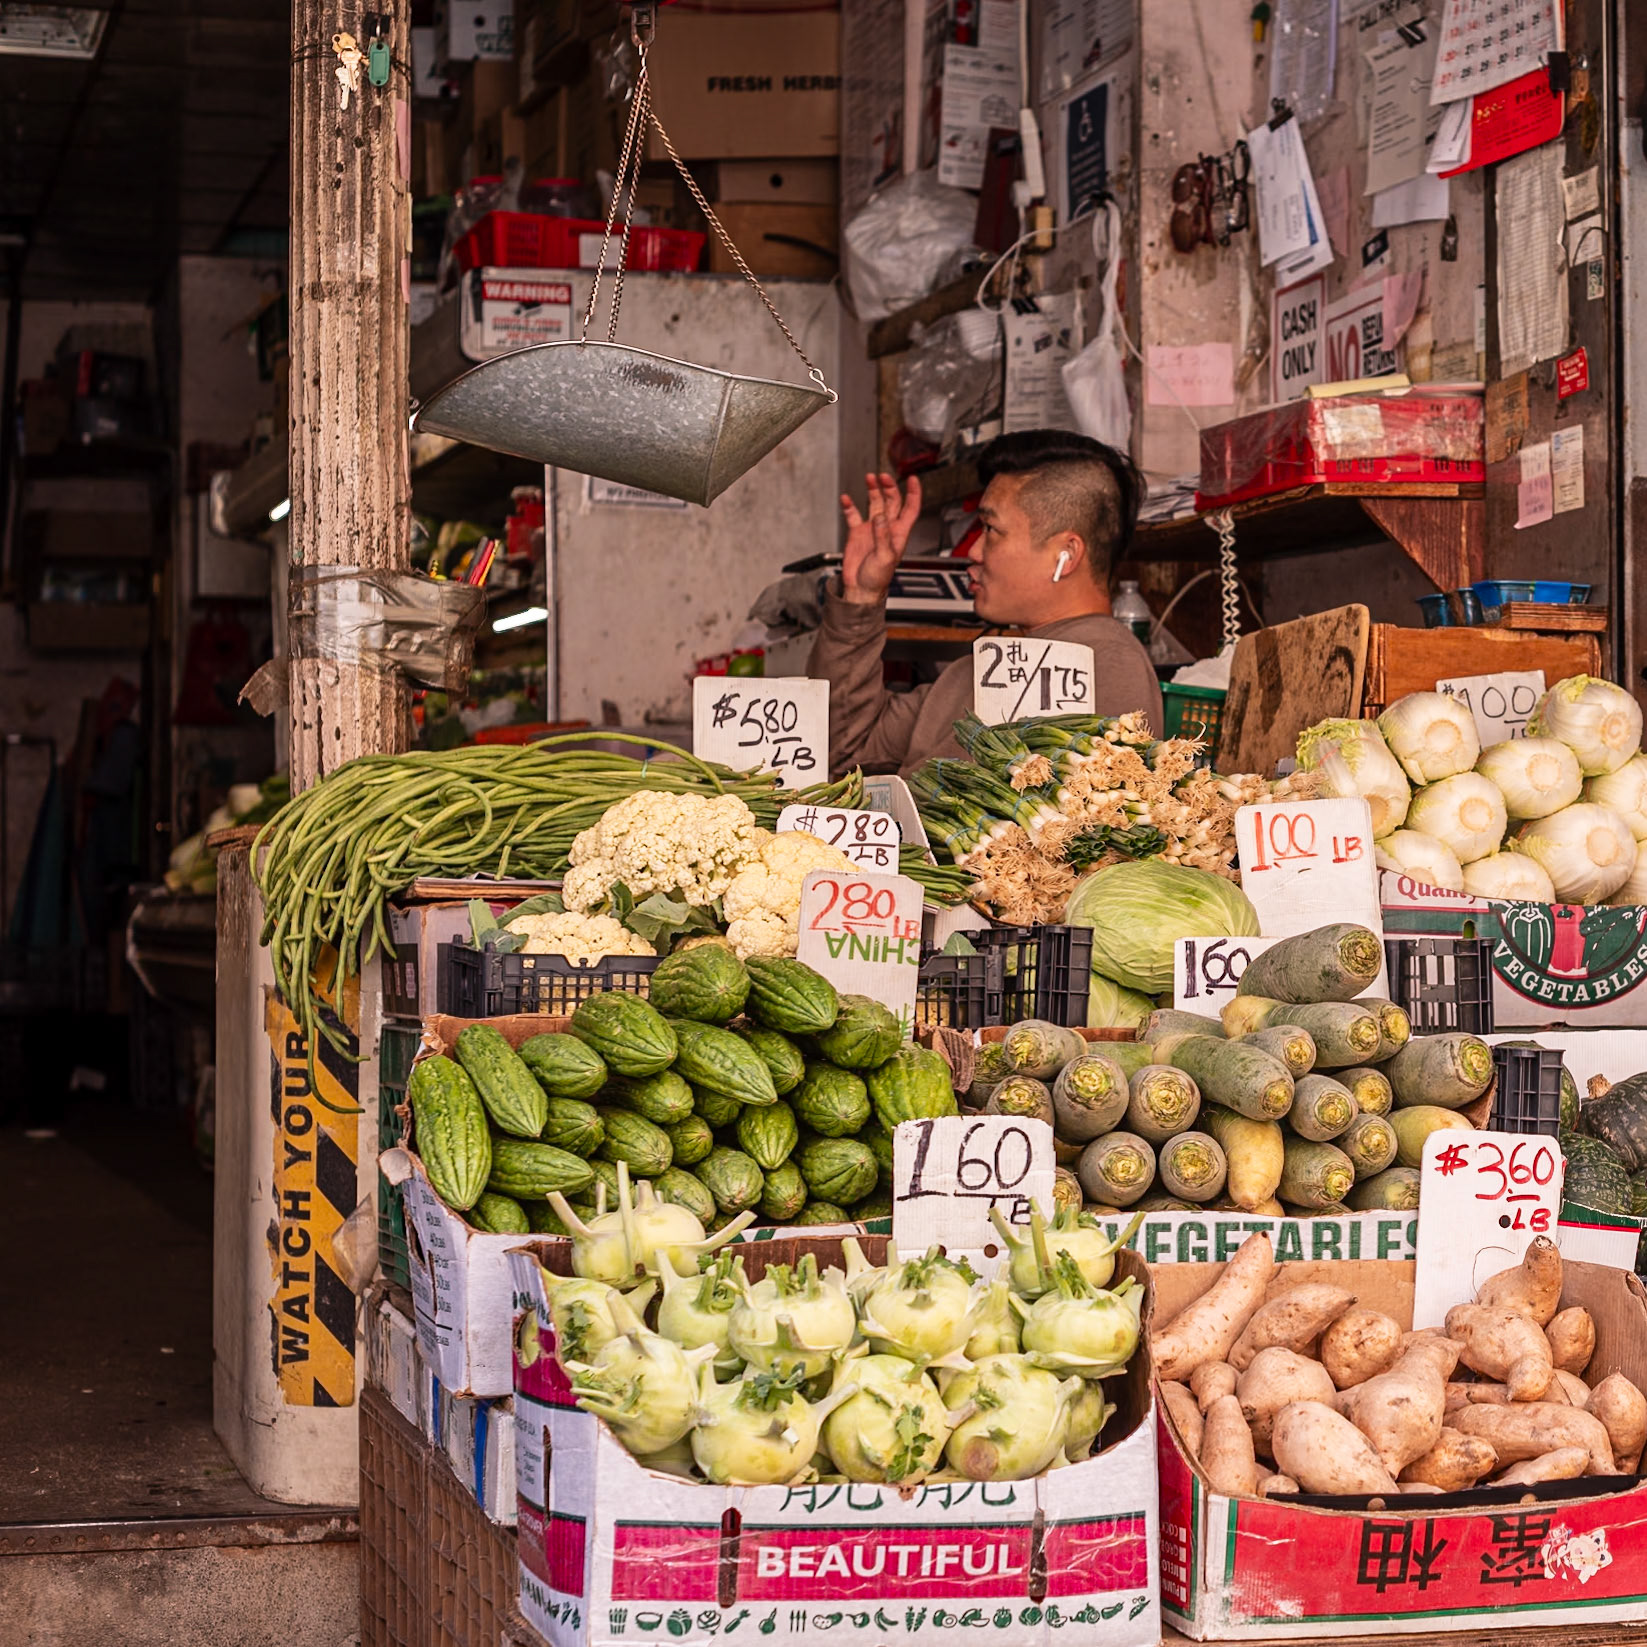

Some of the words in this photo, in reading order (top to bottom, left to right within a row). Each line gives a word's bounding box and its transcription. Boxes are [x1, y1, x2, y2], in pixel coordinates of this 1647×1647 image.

[707, 76, 772, 92] FRESH
[484, 283, 570, 302] WARNING
[1282, 299, 1316, 341] CASH
[1282, 341, 1316, 381] ONLY
[1328, 324, 1361, 382] NO
[979, 641, 1009, 688] 2
[771, 746, 817, 771] LB
[853, 846, 890, 867] LB
[1331, 835, 1365, 864] LB
[892, 914, 921, 941] LB
[824, 930, 920, 966] CHINA
[1492, 938, 1647, 1003] VEGETABLES
[283, 1030, 315, 1171] YOUR
[1511, 1207, 1552, 1233] LB
[281, 1189, 312, 1365] WATCH
[757, 1543, 1023, 1579] BEAUTIFUL
